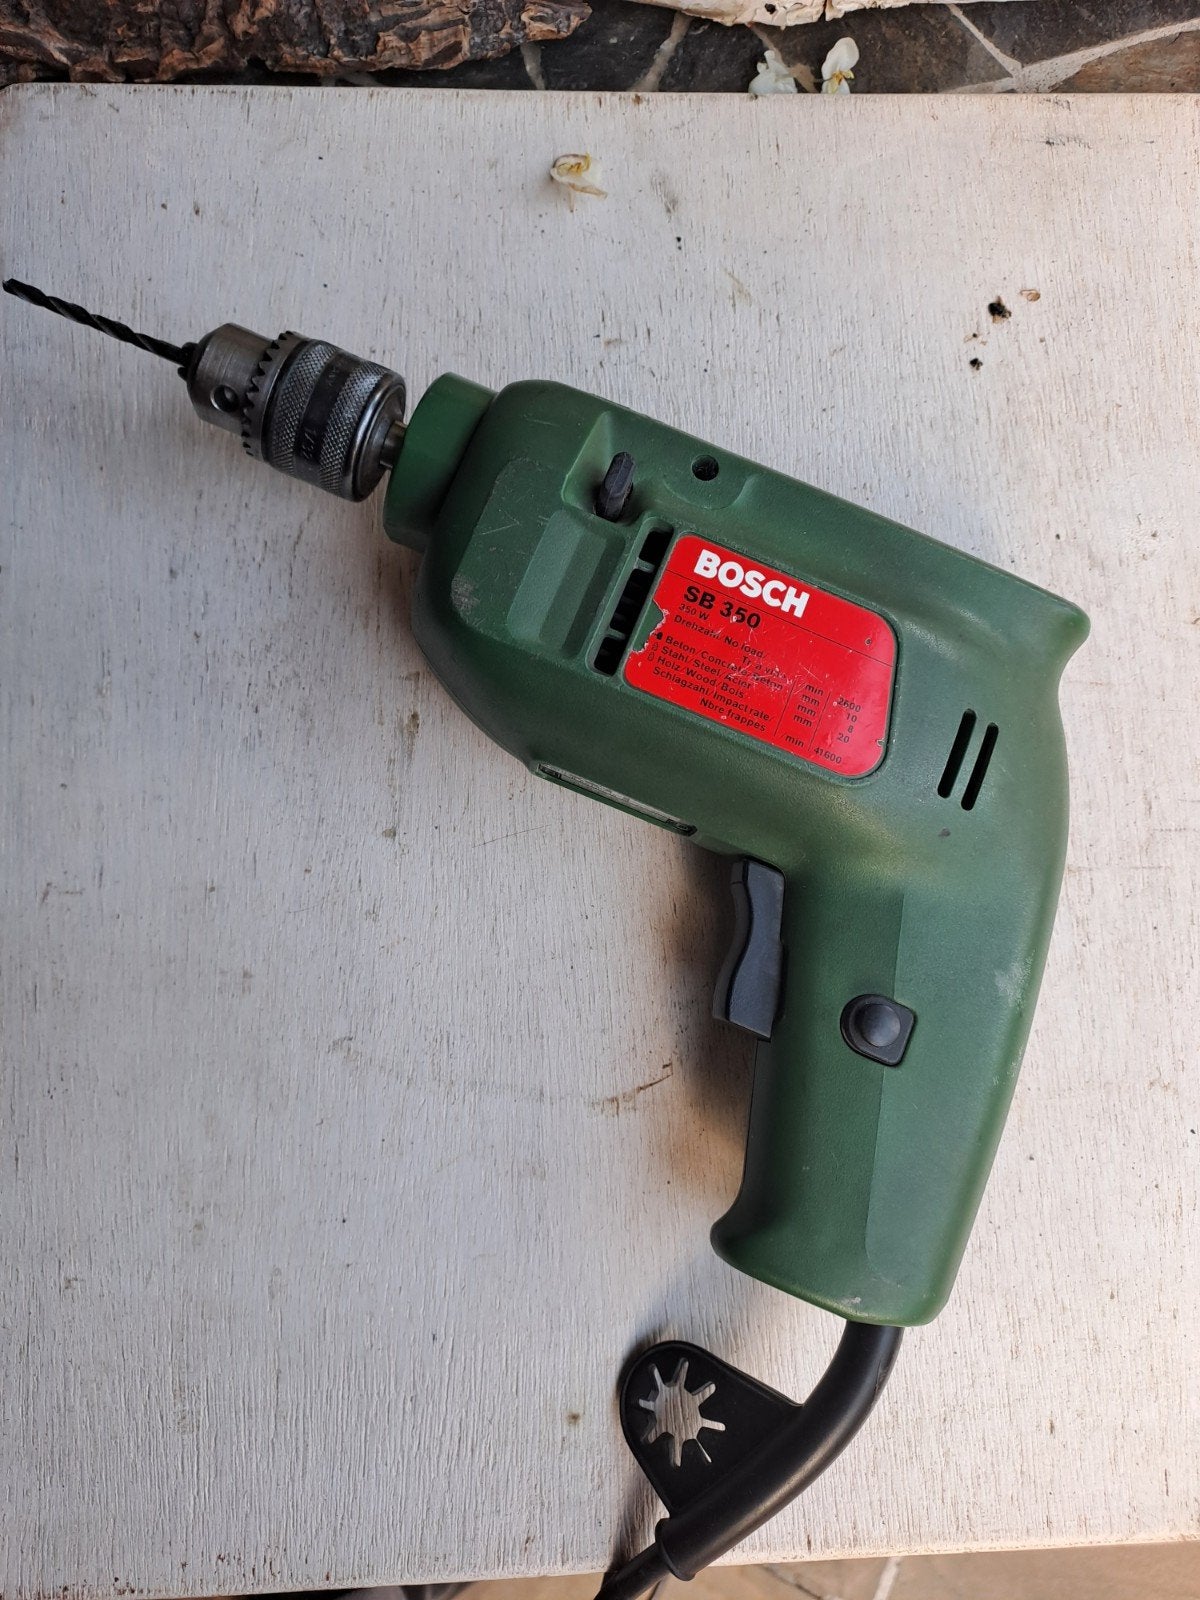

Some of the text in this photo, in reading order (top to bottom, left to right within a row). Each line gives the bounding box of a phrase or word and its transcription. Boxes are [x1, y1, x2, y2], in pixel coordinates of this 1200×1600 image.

[693, 549, 810, 618] BOSCH
[678, 603, 710, 621] 350 W
[684, 585, 761, 629] SB 350
[797, 704, 816, 717] mm
[847, 725, 854, 734] 8
[801, 694, 820, 707] mm
[846, 713, 857, 723] 10
[837, 697, 861, 712] 2600
[700, 697, 725, 713] Nbre
[727, 709, 766, 732] frappes
[813, 746, 842, 764] 41600
[793, 714, 812, 727] mm
[837, 732, 850, 743] 20
